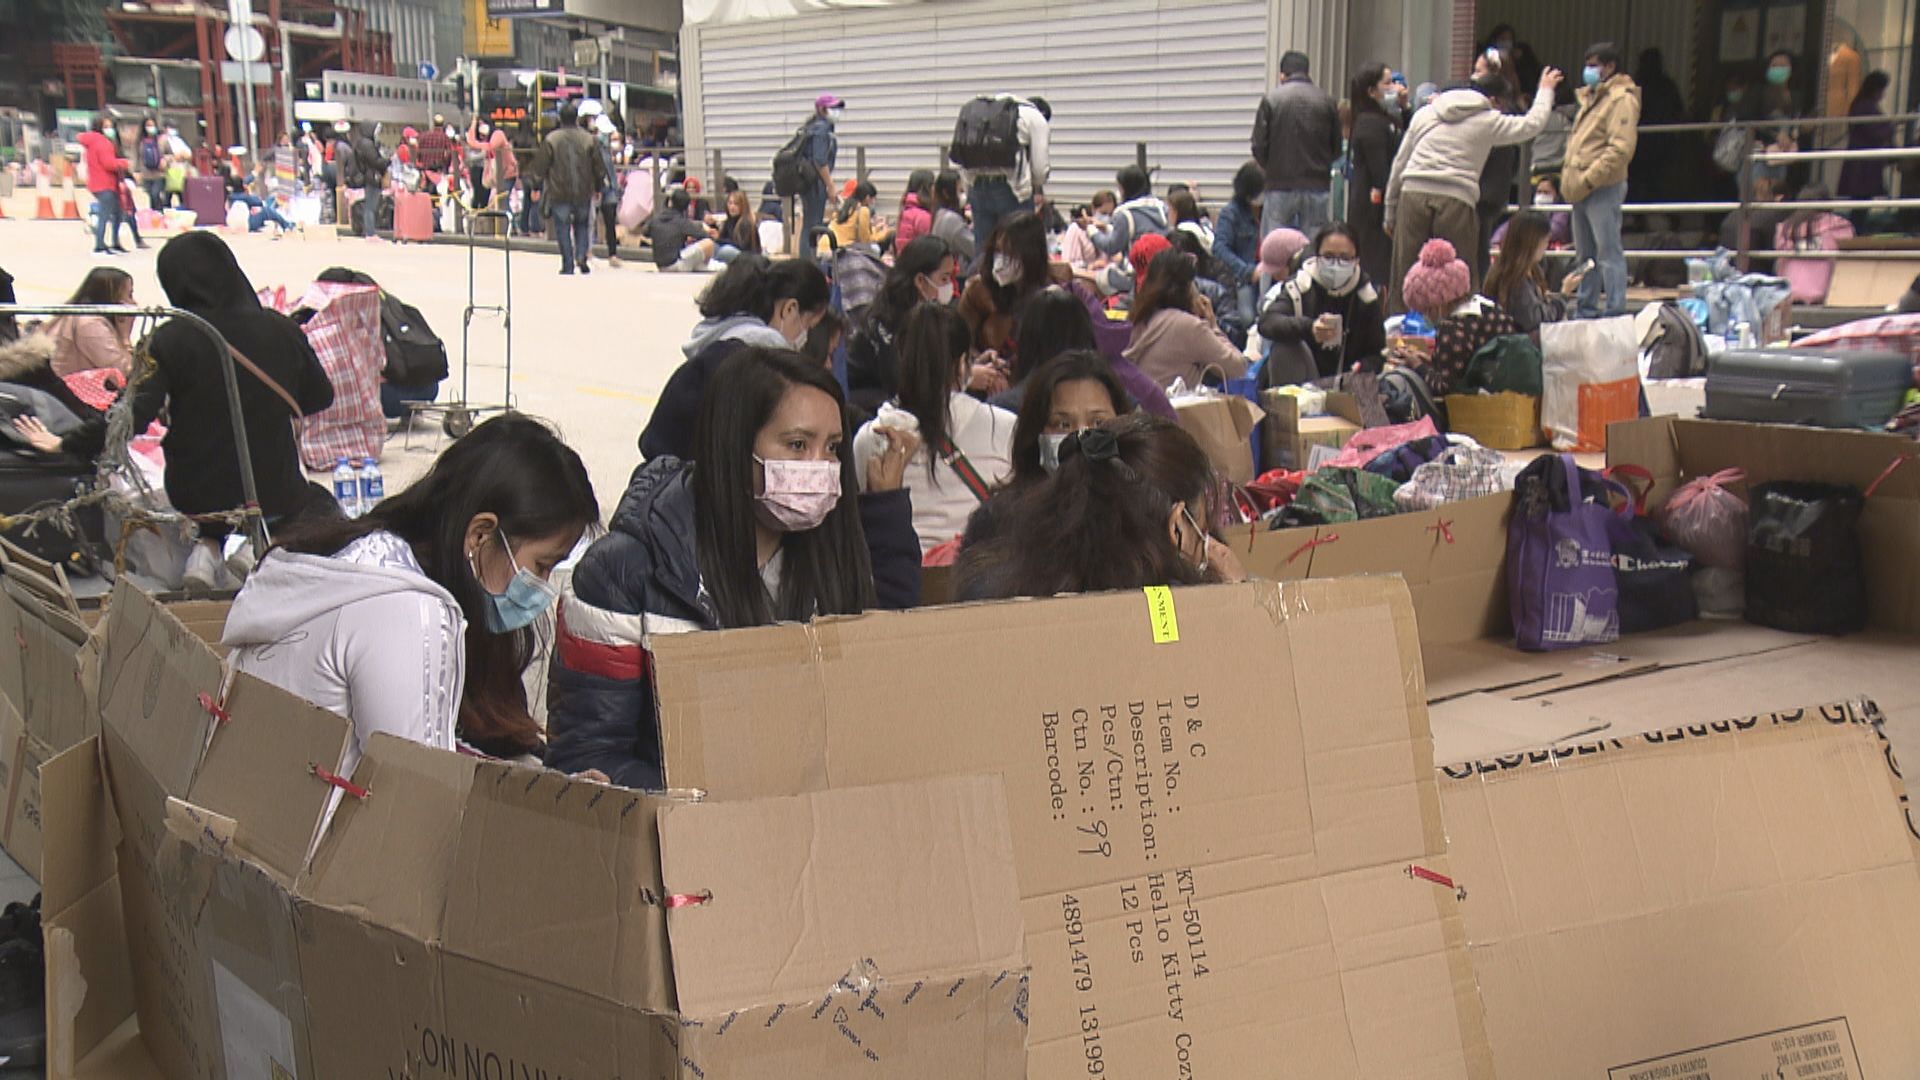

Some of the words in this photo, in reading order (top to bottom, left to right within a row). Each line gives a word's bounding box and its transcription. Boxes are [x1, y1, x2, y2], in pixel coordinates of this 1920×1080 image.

[1152, 587, 1170, 638] NMENT
[1184, 693, 1199, 709] D
[1072, 708, 1088, 751] Ctn
[1187, 718, 1202, 733] &
[1100, 704, 1123, 811] Pcs/Ctn:
[1190, 742, 1206, 757] C
[1157, 698, 1173, 753] Item
[1176, 868, 1210, 979] KT-50114
[1042, 712, 1067, 821] Barcode:
[1062, 894, 1093, 992] 4891479
[1080, 1004, 1106, 1080] 13199
[1120, 883, 1139, 911] 12
[1129, 700, 1157, 861] Description:
[1147, 872, 1171, 943] Hello
[1162, 952, 1183, 1022] Kitty
[1176, 1033, 1194, 1080] Coz
[1126, 919, 1144, 963] Pcs
